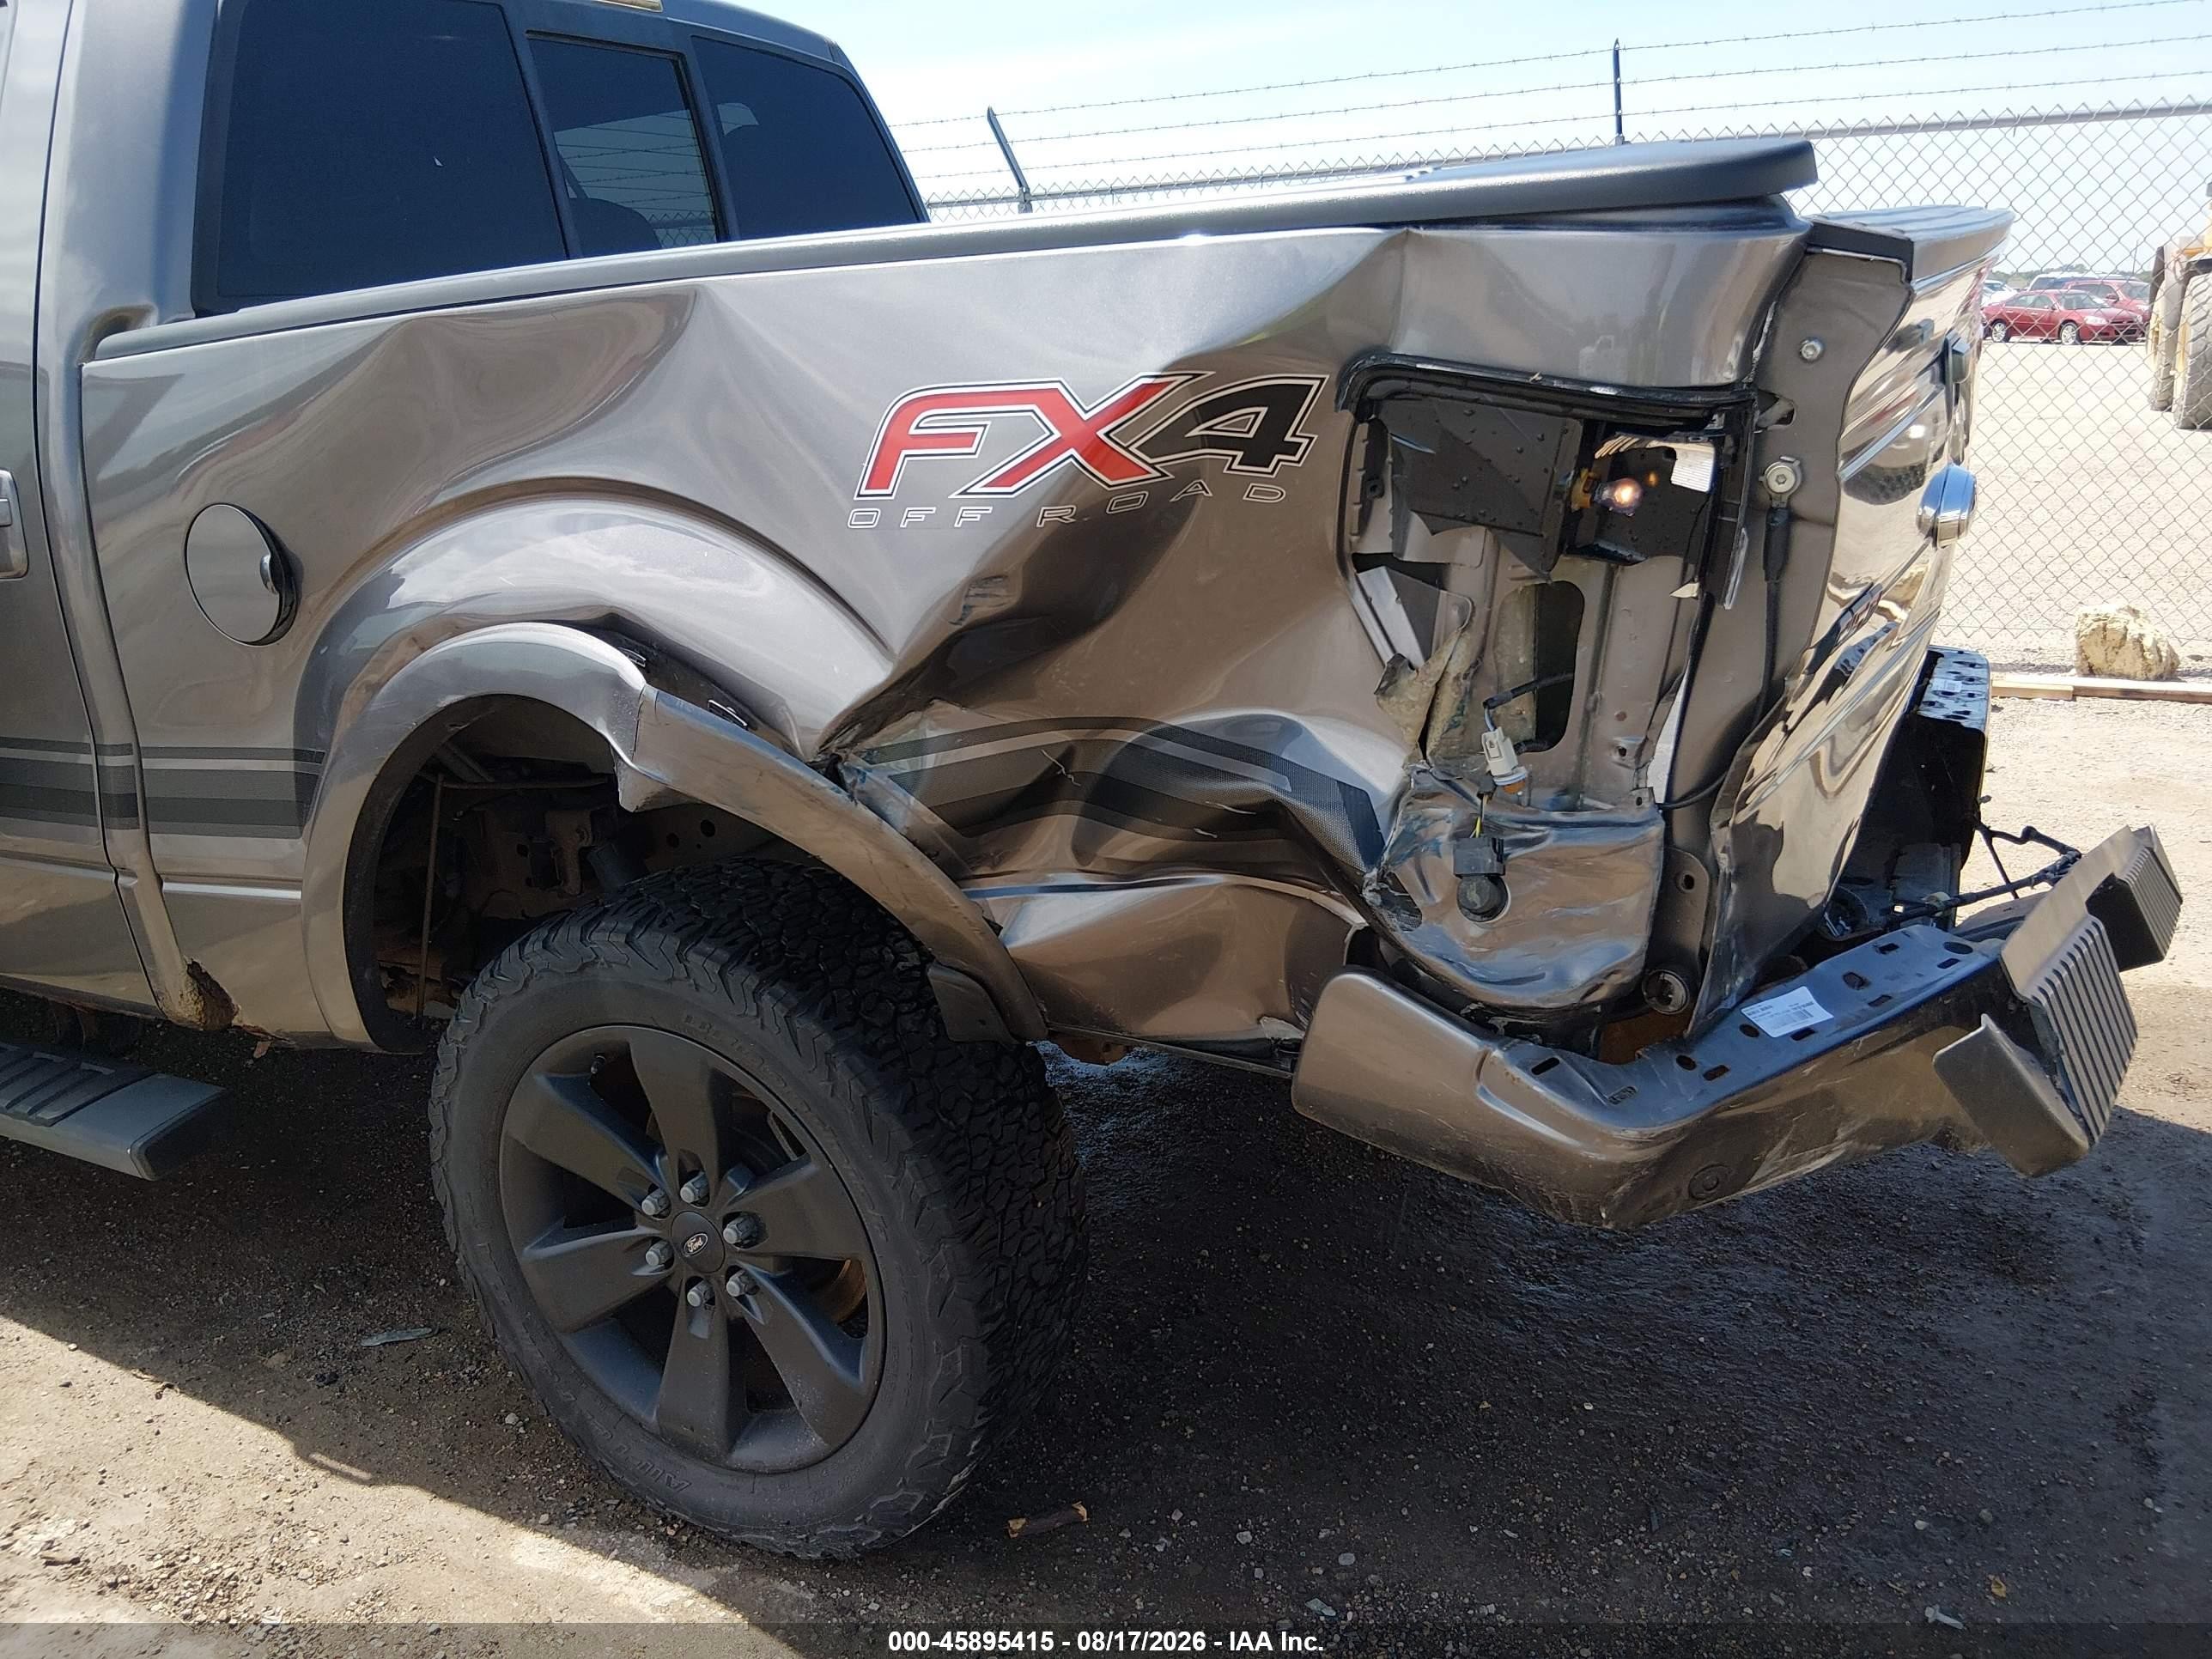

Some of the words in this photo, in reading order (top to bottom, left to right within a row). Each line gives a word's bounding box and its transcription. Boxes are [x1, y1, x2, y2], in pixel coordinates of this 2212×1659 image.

[854, 371, 1329, 500] FX4
[847, 506, 993, 529] OFF
[1036, 479, 1287, 527] ROAD
